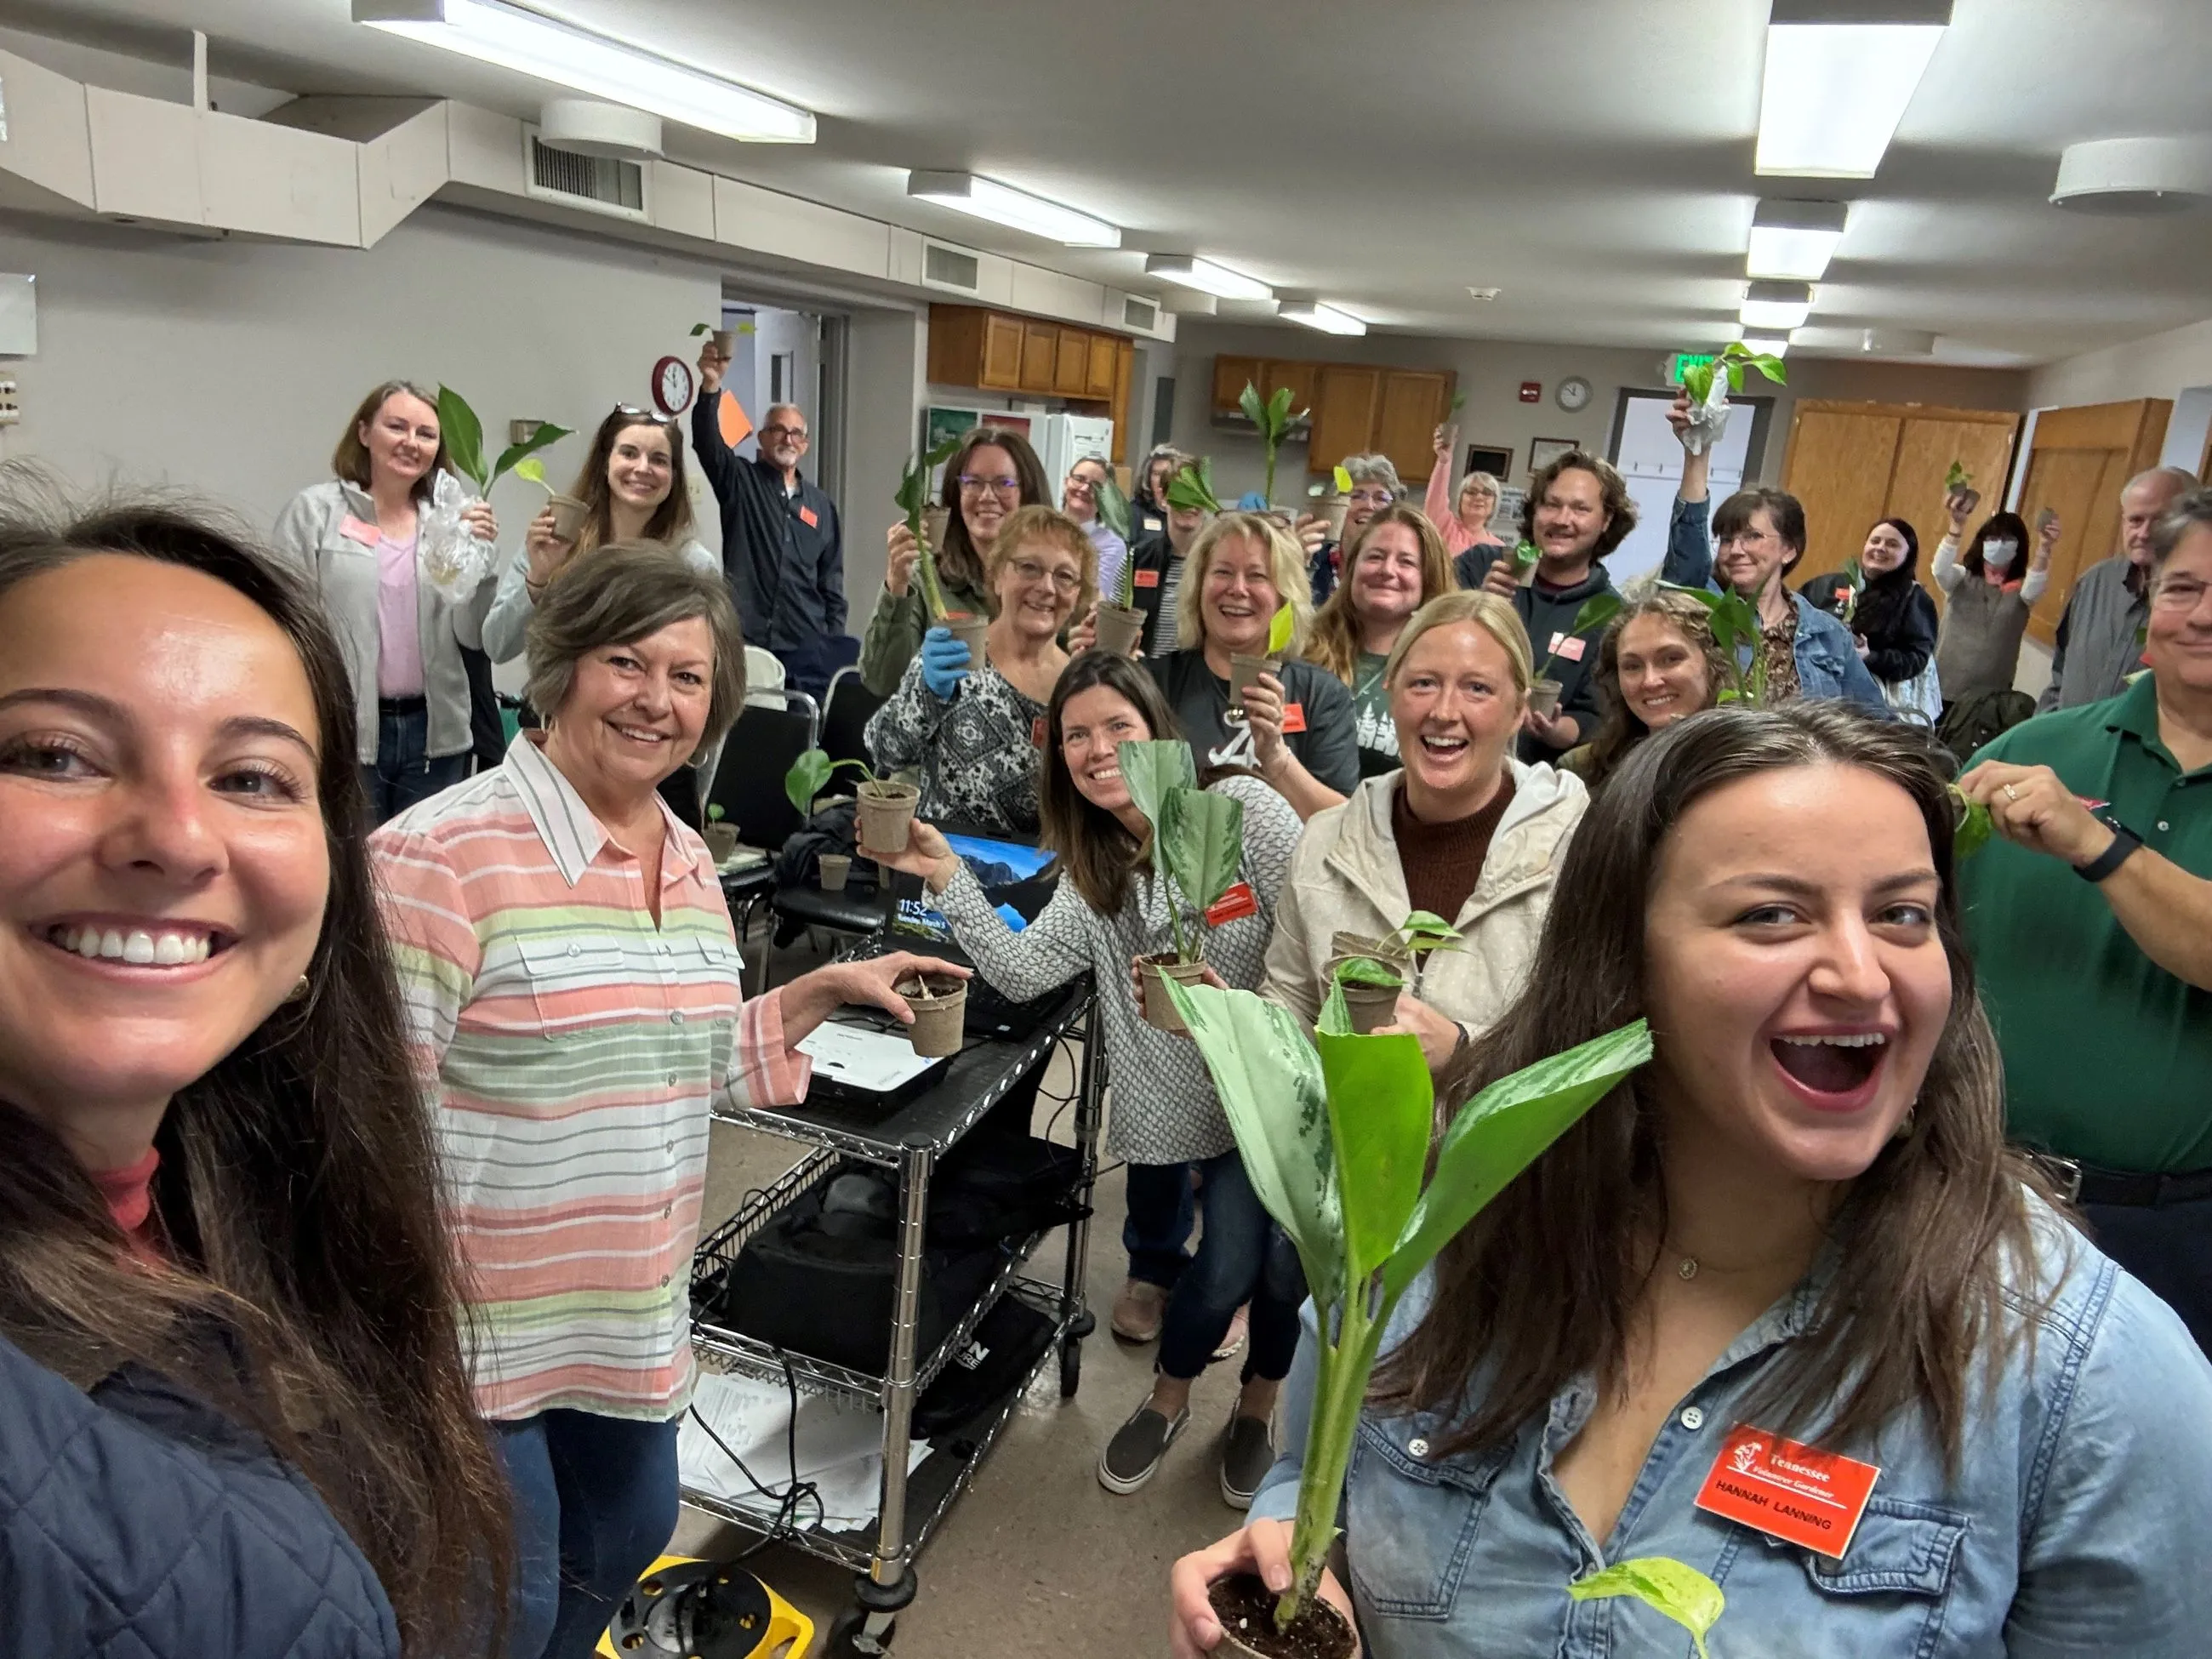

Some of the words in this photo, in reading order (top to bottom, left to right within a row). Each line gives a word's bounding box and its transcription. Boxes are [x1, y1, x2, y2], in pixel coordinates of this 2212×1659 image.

[899, 898, 927, 917] 11:52
[1752, 1465, 1793, 1486] Volunteer
[1793, 1479, 1834, 1499] Gardener
[1770, 1454, 1831, 1482] Tennessee
[1715, 1479, 1769, 1507] HANNAH
[1773, 1501, 1832, 1530] LANNING
